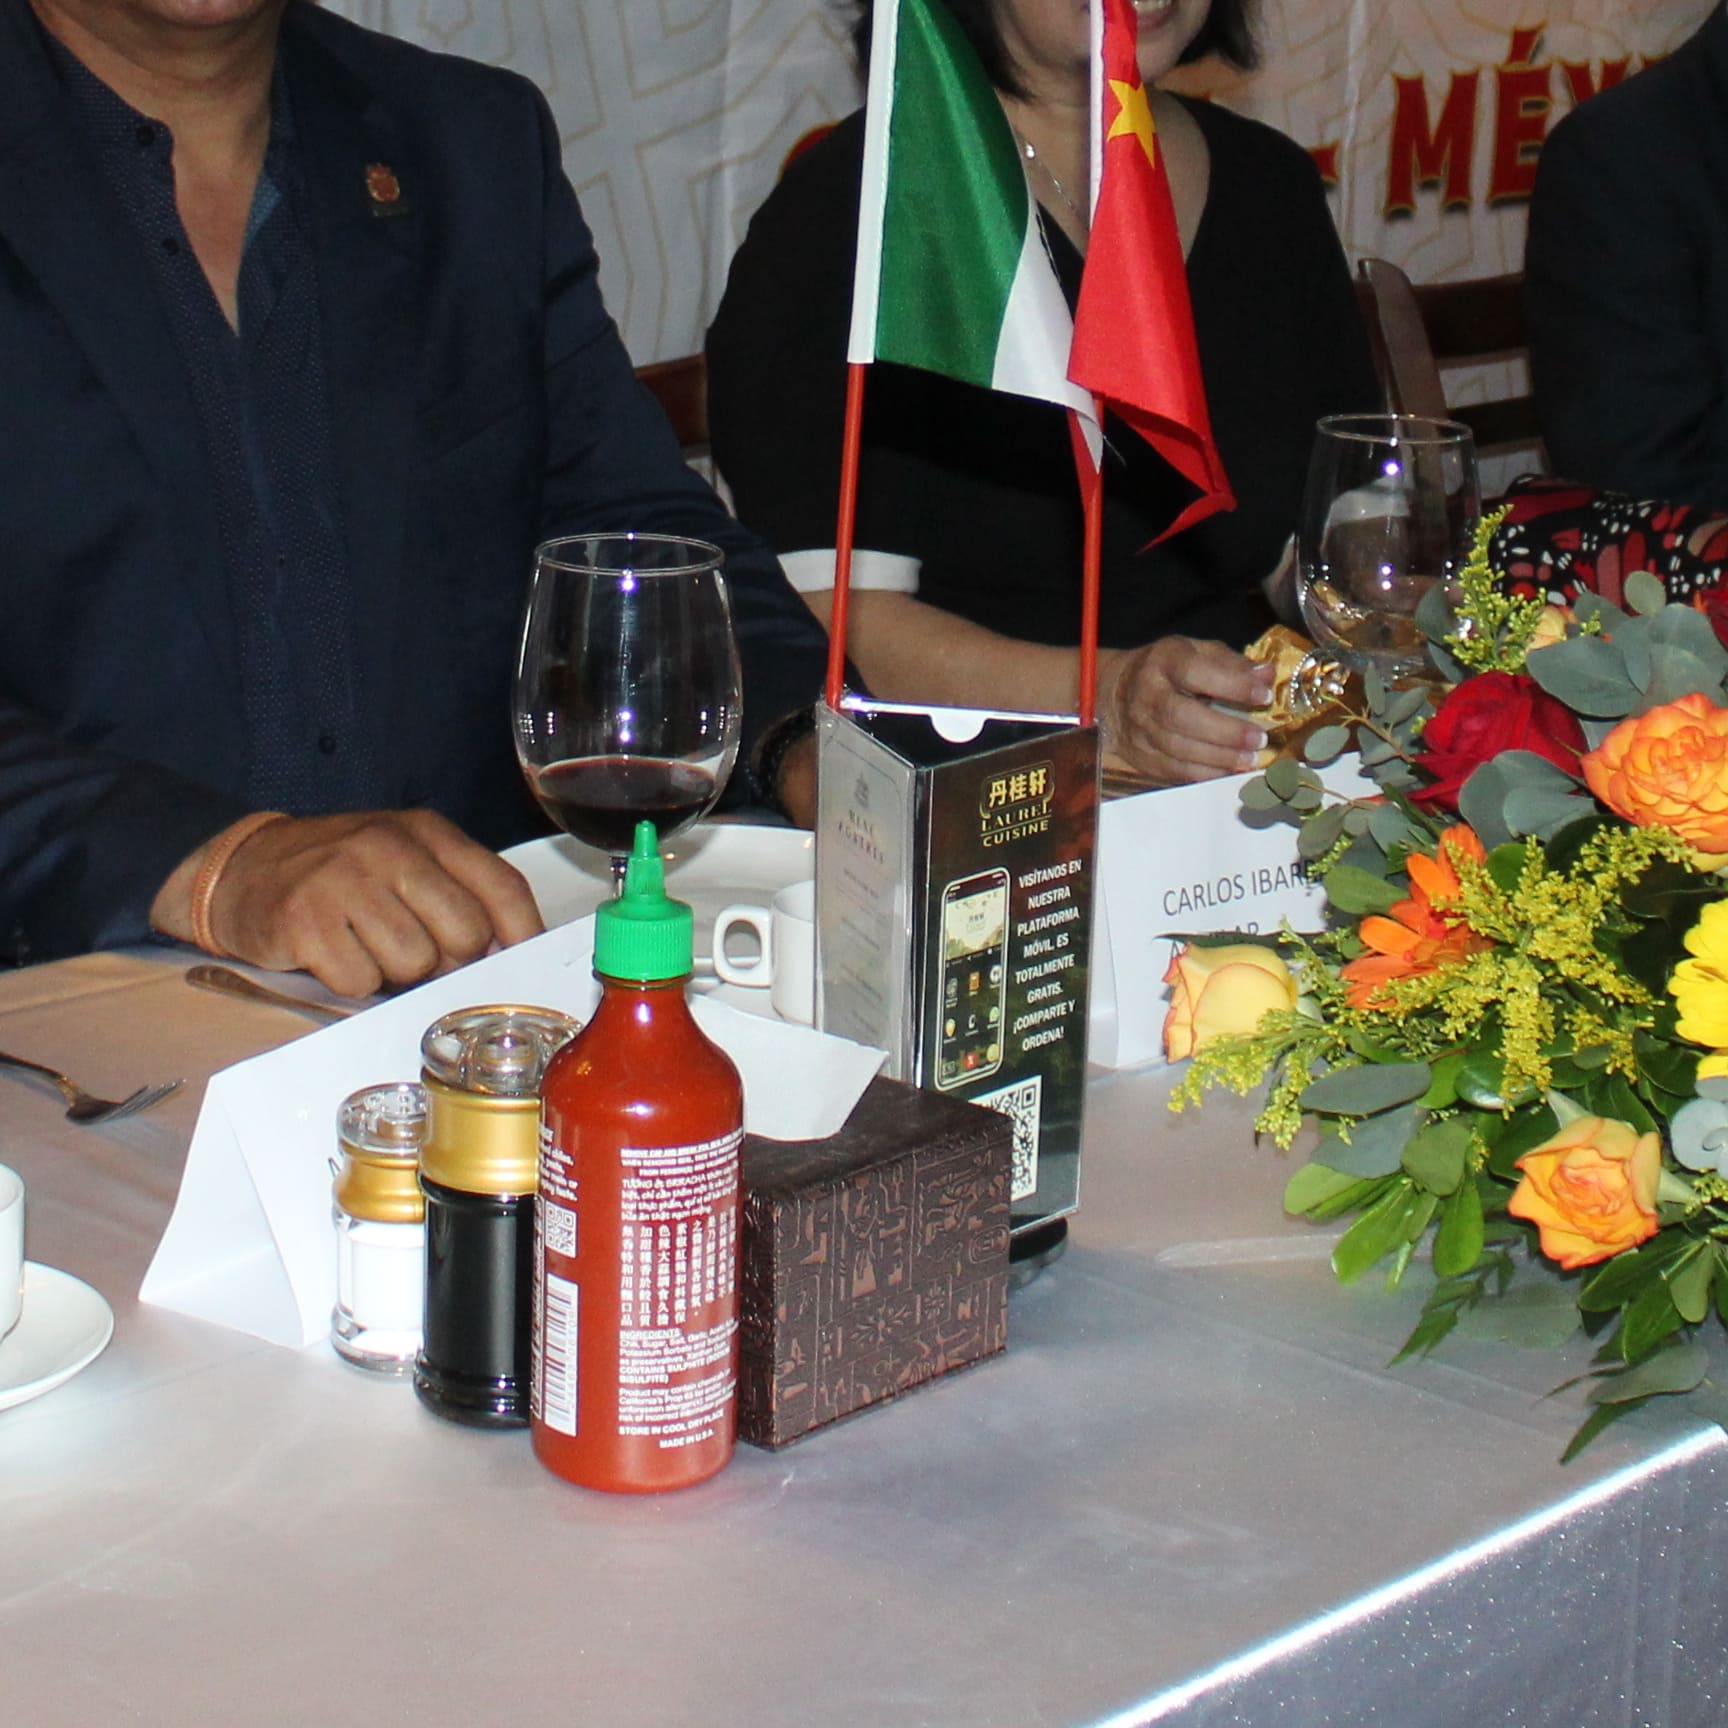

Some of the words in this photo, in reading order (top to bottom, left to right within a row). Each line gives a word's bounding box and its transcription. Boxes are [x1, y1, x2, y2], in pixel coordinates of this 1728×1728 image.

[982, 800, 1052, 832] LAUREL
[983, 819, 1049, 847] CUISINE
[1019, 864, 1067, 889] VISÍTANOS
[1068, 859, 1082, 873] EN
[1028, 886, 1071, 909] NUESTRA
[1163, 874, 1246, 916] CARLOS
[1017, 907, 1080, 936] PLATAFORMA
[1057, 933, 1069, 947] ES
[1015, 954, 1075, 984] TOTALMENTE
[1027, 982, 1063, 1003] GRATIS.
[1068, 1000, 1076, 1012] Y
[1022, 1027, 1064, 1051] ORDENA!
[619, 1425, 650, 1436] STORE
[651, 1425, 662, 1435] IN
[662, 1422, 687, 1435] COOL
[659, 1437, 684, 1448] MADE
[685, 1433, 696, 1444] IN
